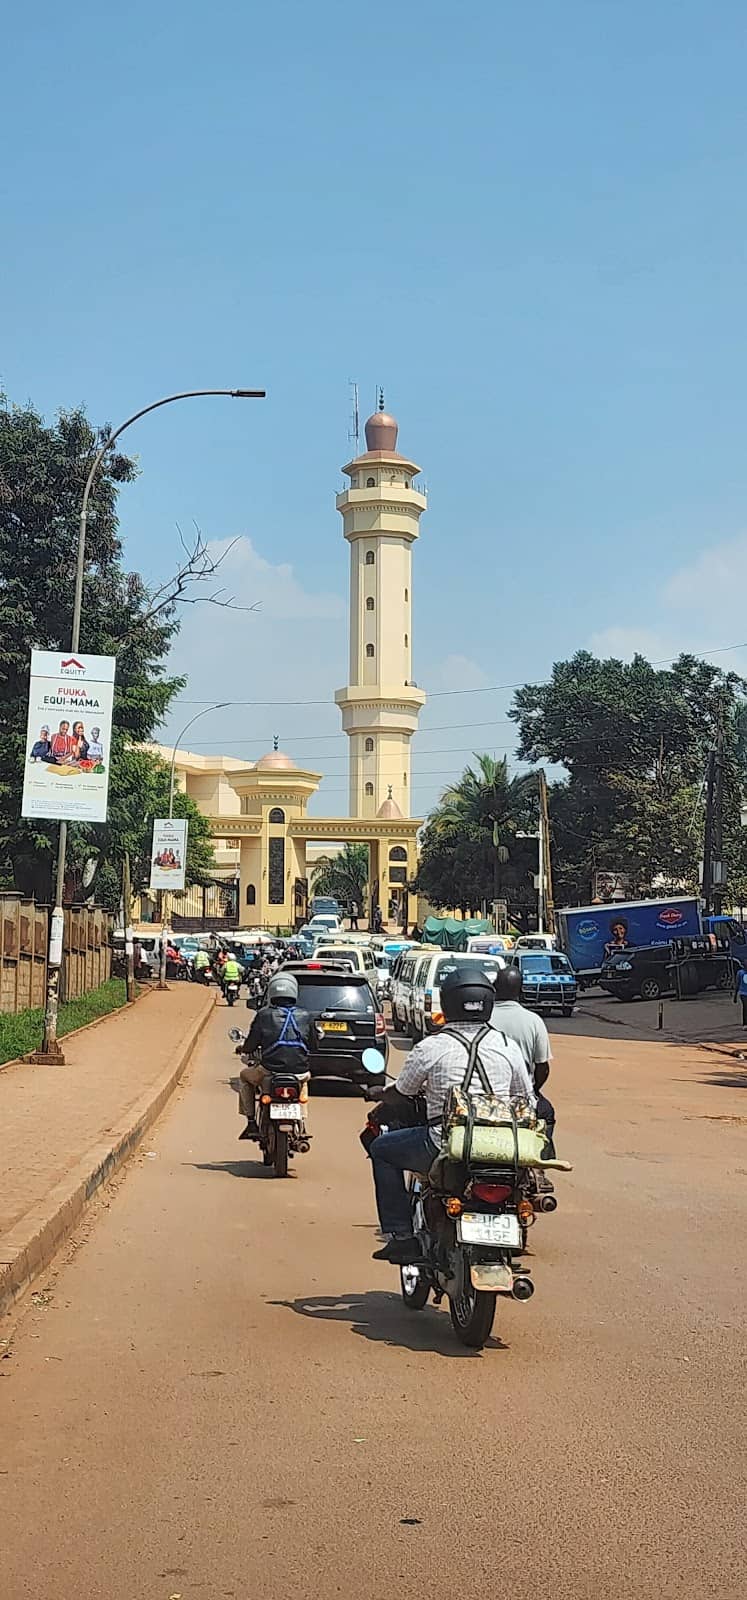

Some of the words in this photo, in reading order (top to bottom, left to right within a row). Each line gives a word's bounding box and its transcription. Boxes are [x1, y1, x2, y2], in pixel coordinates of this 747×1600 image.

[60, 668, 86, 676] EQUITY
[57, 687, 87, 697] FUUKA
[43, 695, 100, 708] EQUI-MAMA
